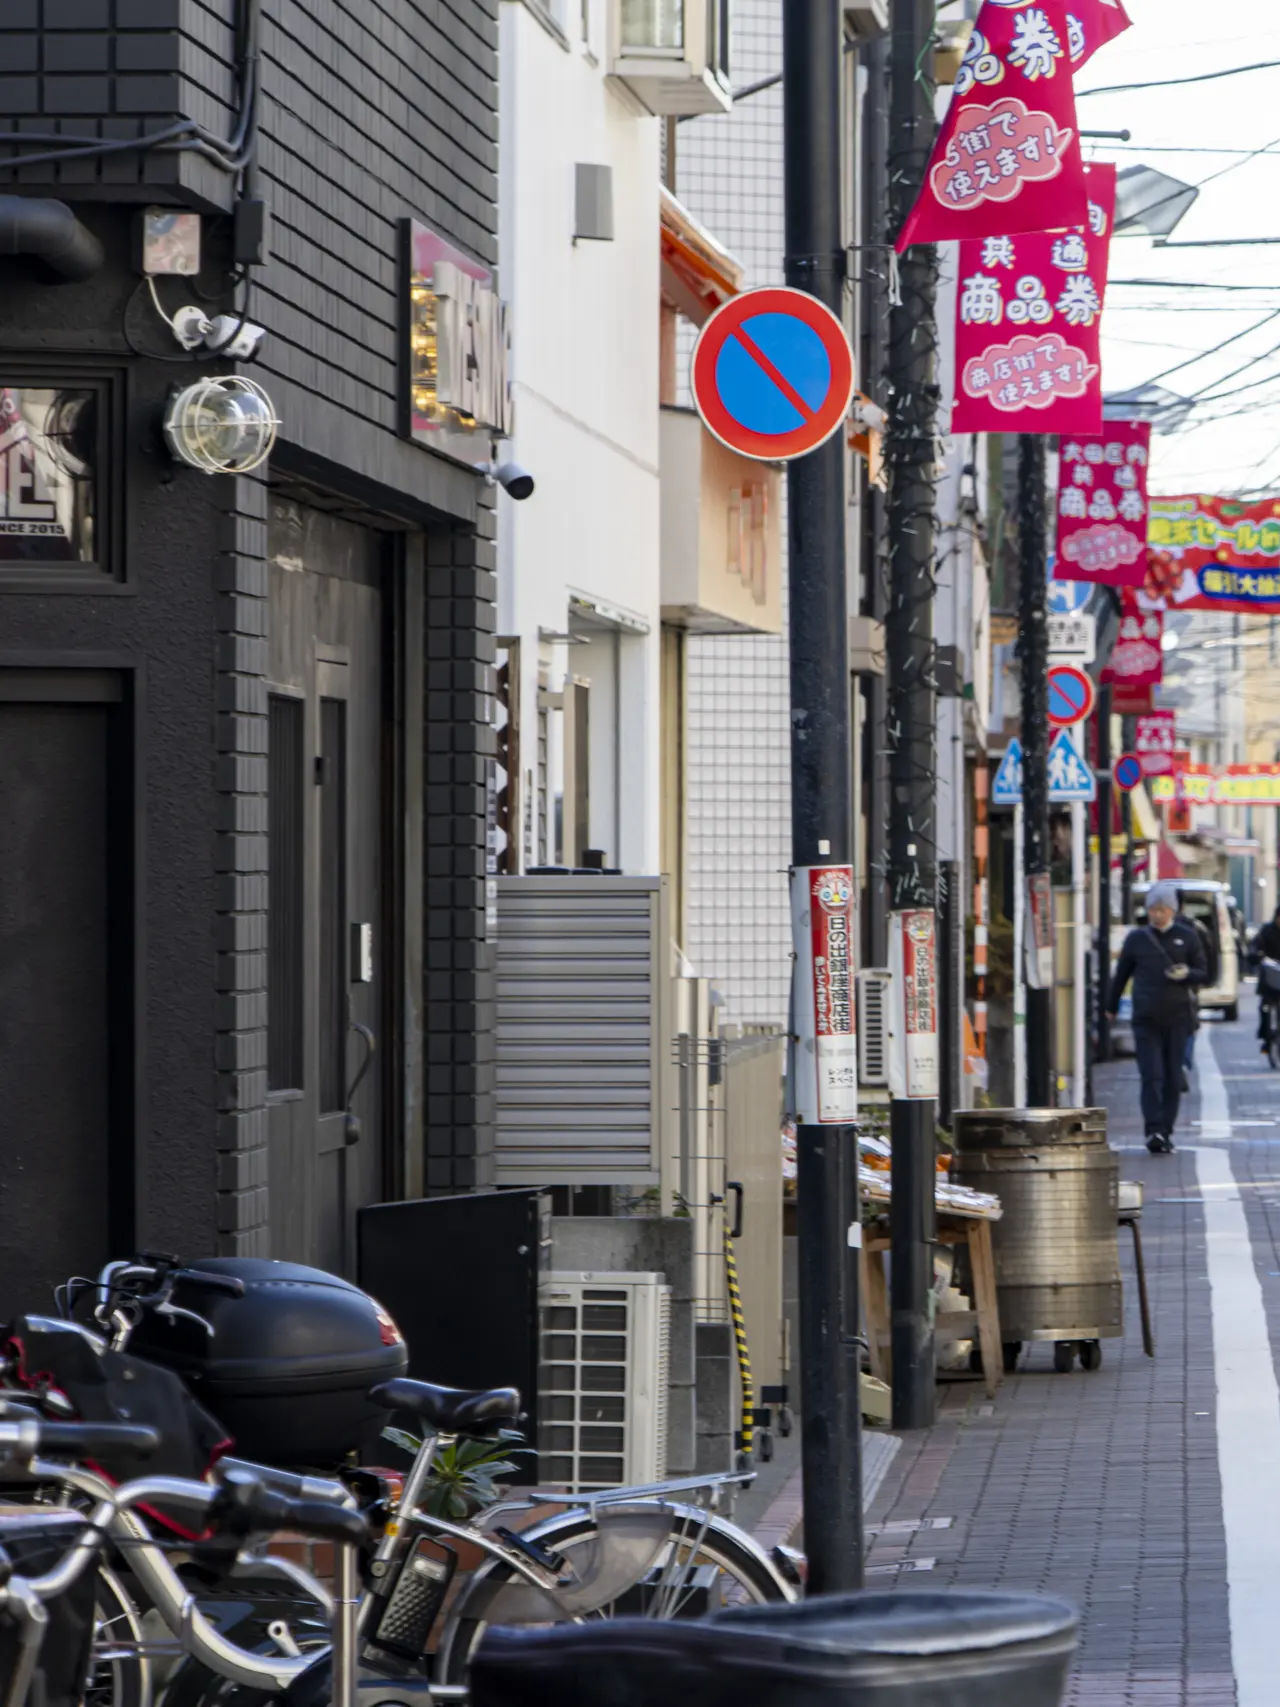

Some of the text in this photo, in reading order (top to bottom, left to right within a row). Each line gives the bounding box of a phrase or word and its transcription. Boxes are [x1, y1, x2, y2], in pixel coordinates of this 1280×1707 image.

[953, 8, 1064, 95] 品券
[943, 126, 1056, 203] 使えます!
[980, 235, 1089, 271] 共通
[960, 271, 1100, 325] 商品券
[969, 344, 1058, 389] 商店街で
[996, 362, 1086, 406] 使えます!
[1062, 441, 1149, 466] 大田区内
[1059, 485, 1147, 522] 商品券
[28, 522, 65, 535] 2015
